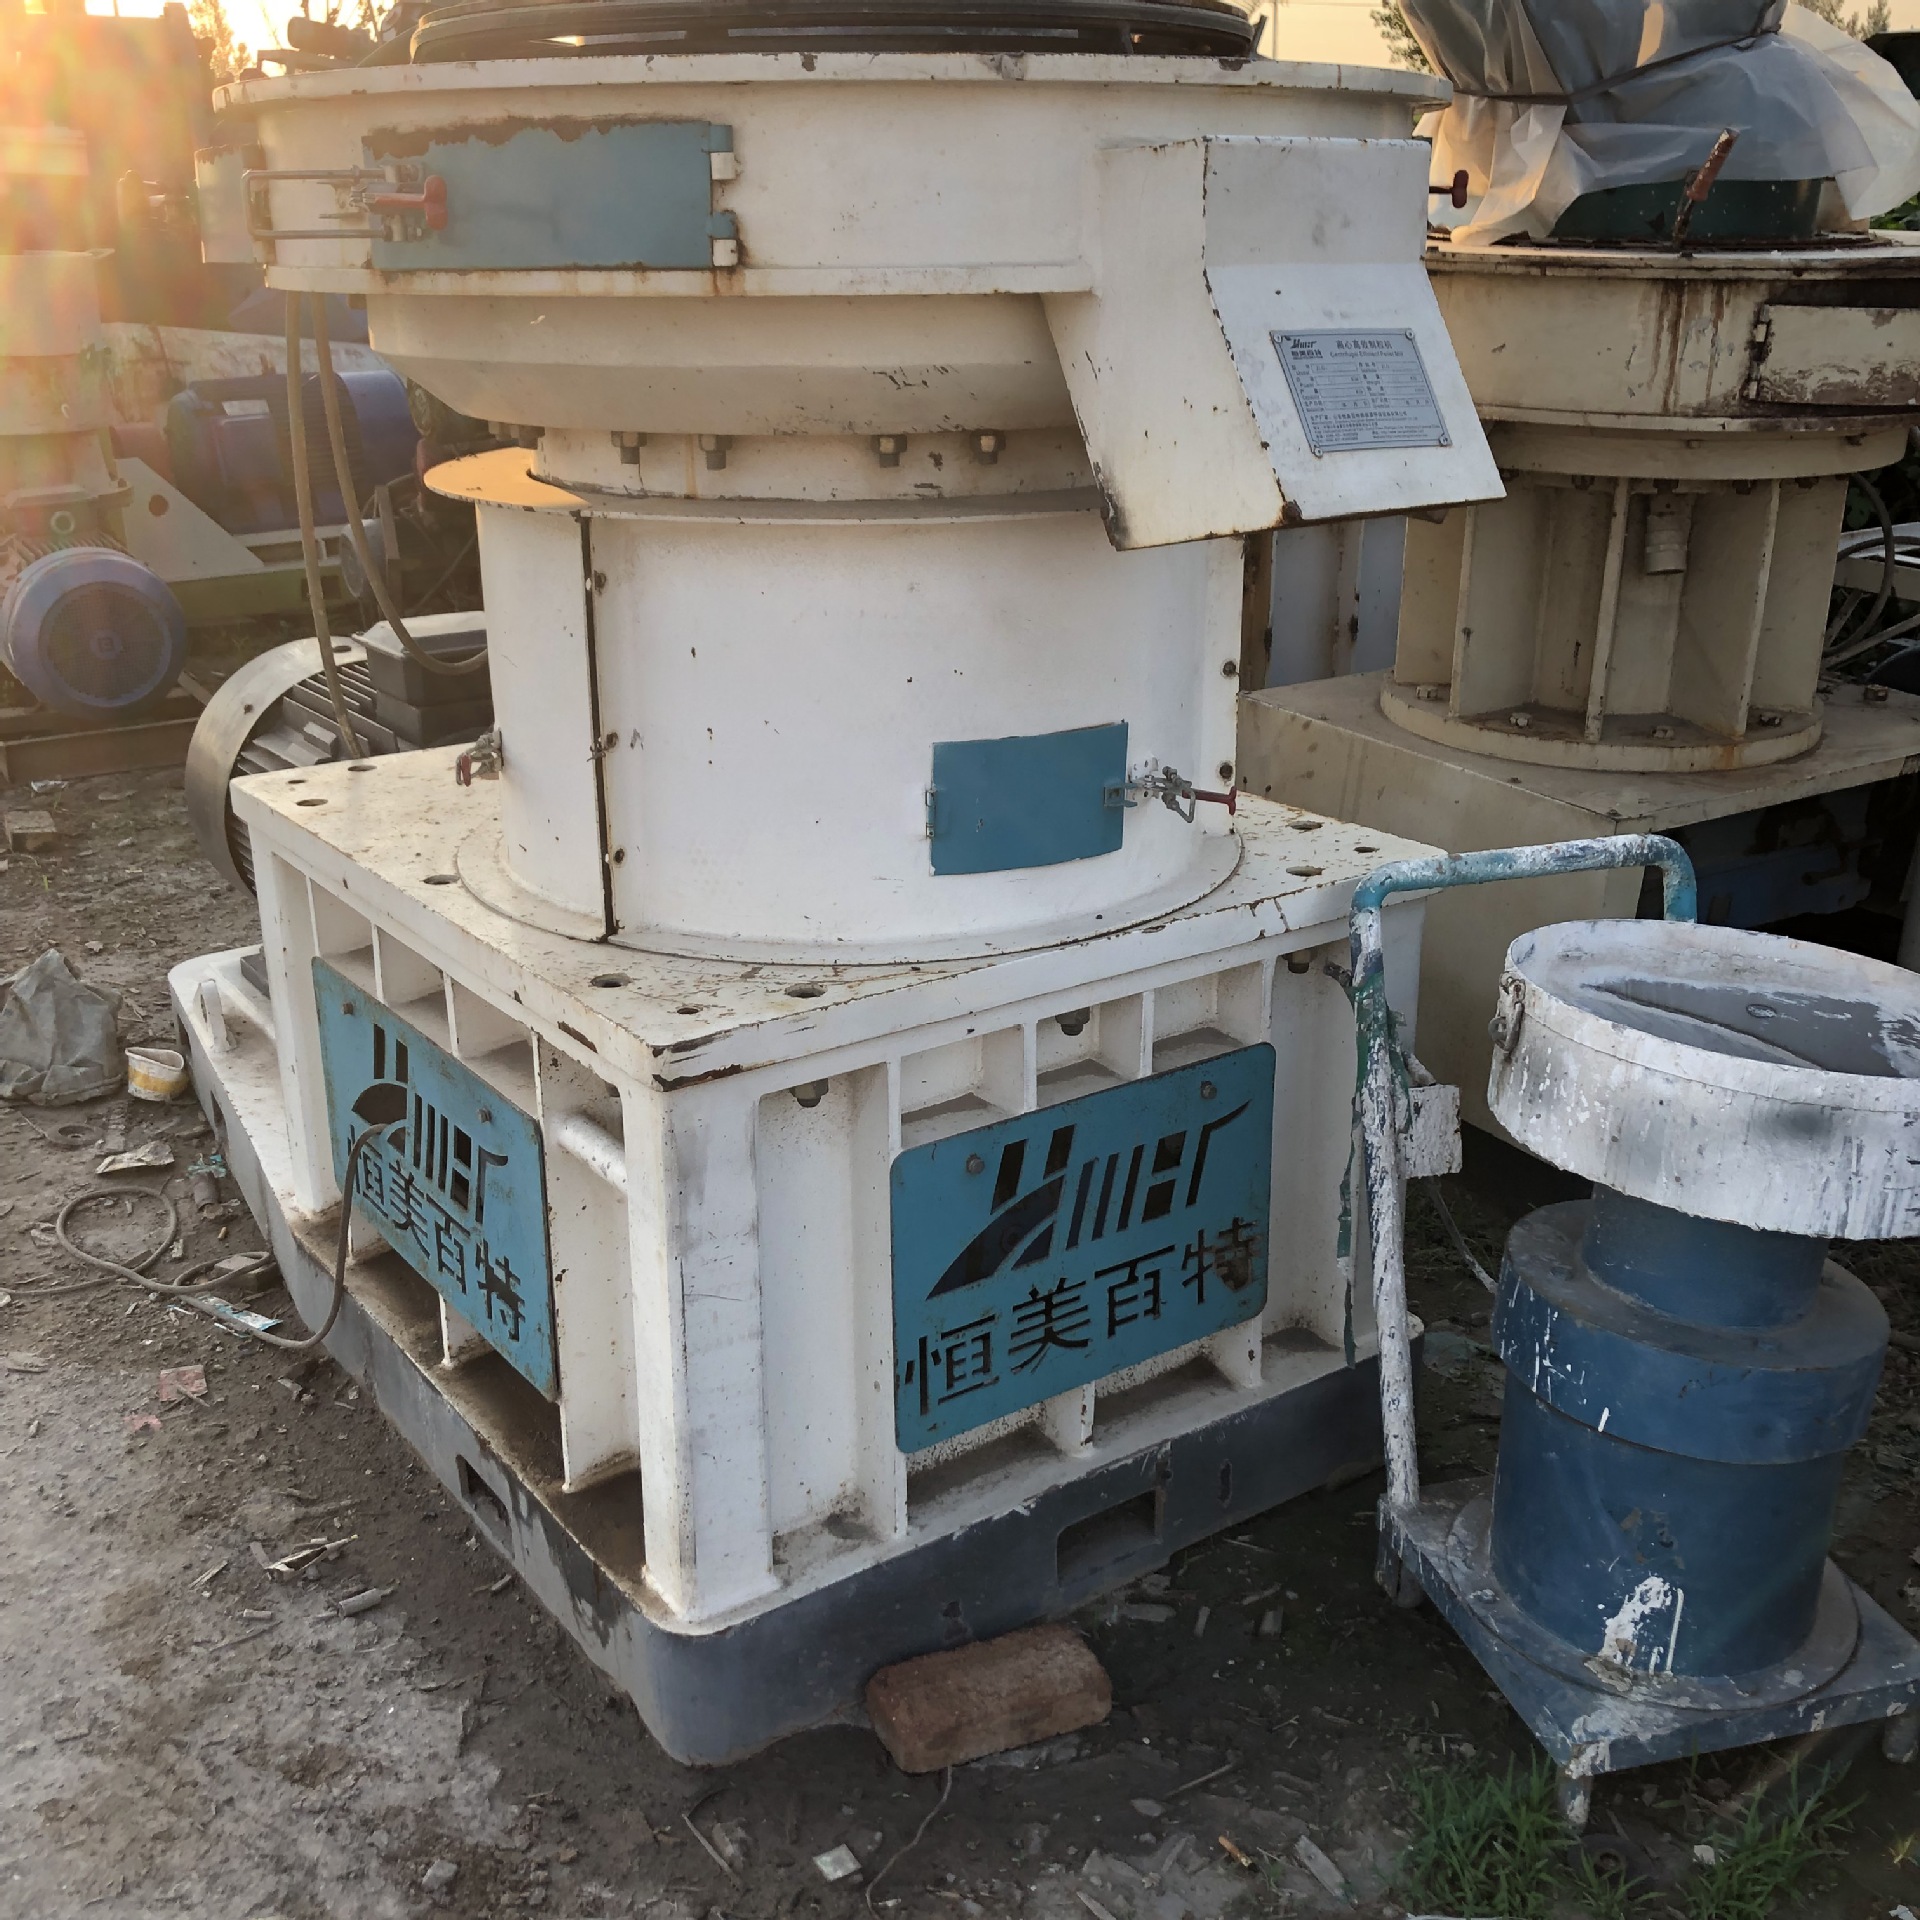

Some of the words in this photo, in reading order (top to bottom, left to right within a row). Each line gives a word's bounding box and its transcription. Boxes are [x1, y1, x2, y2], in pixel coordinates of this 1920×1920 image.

[347, 1124, 526, 1342] 恒美百特
[903, 1217, 1261, 1416] 恒美百特
